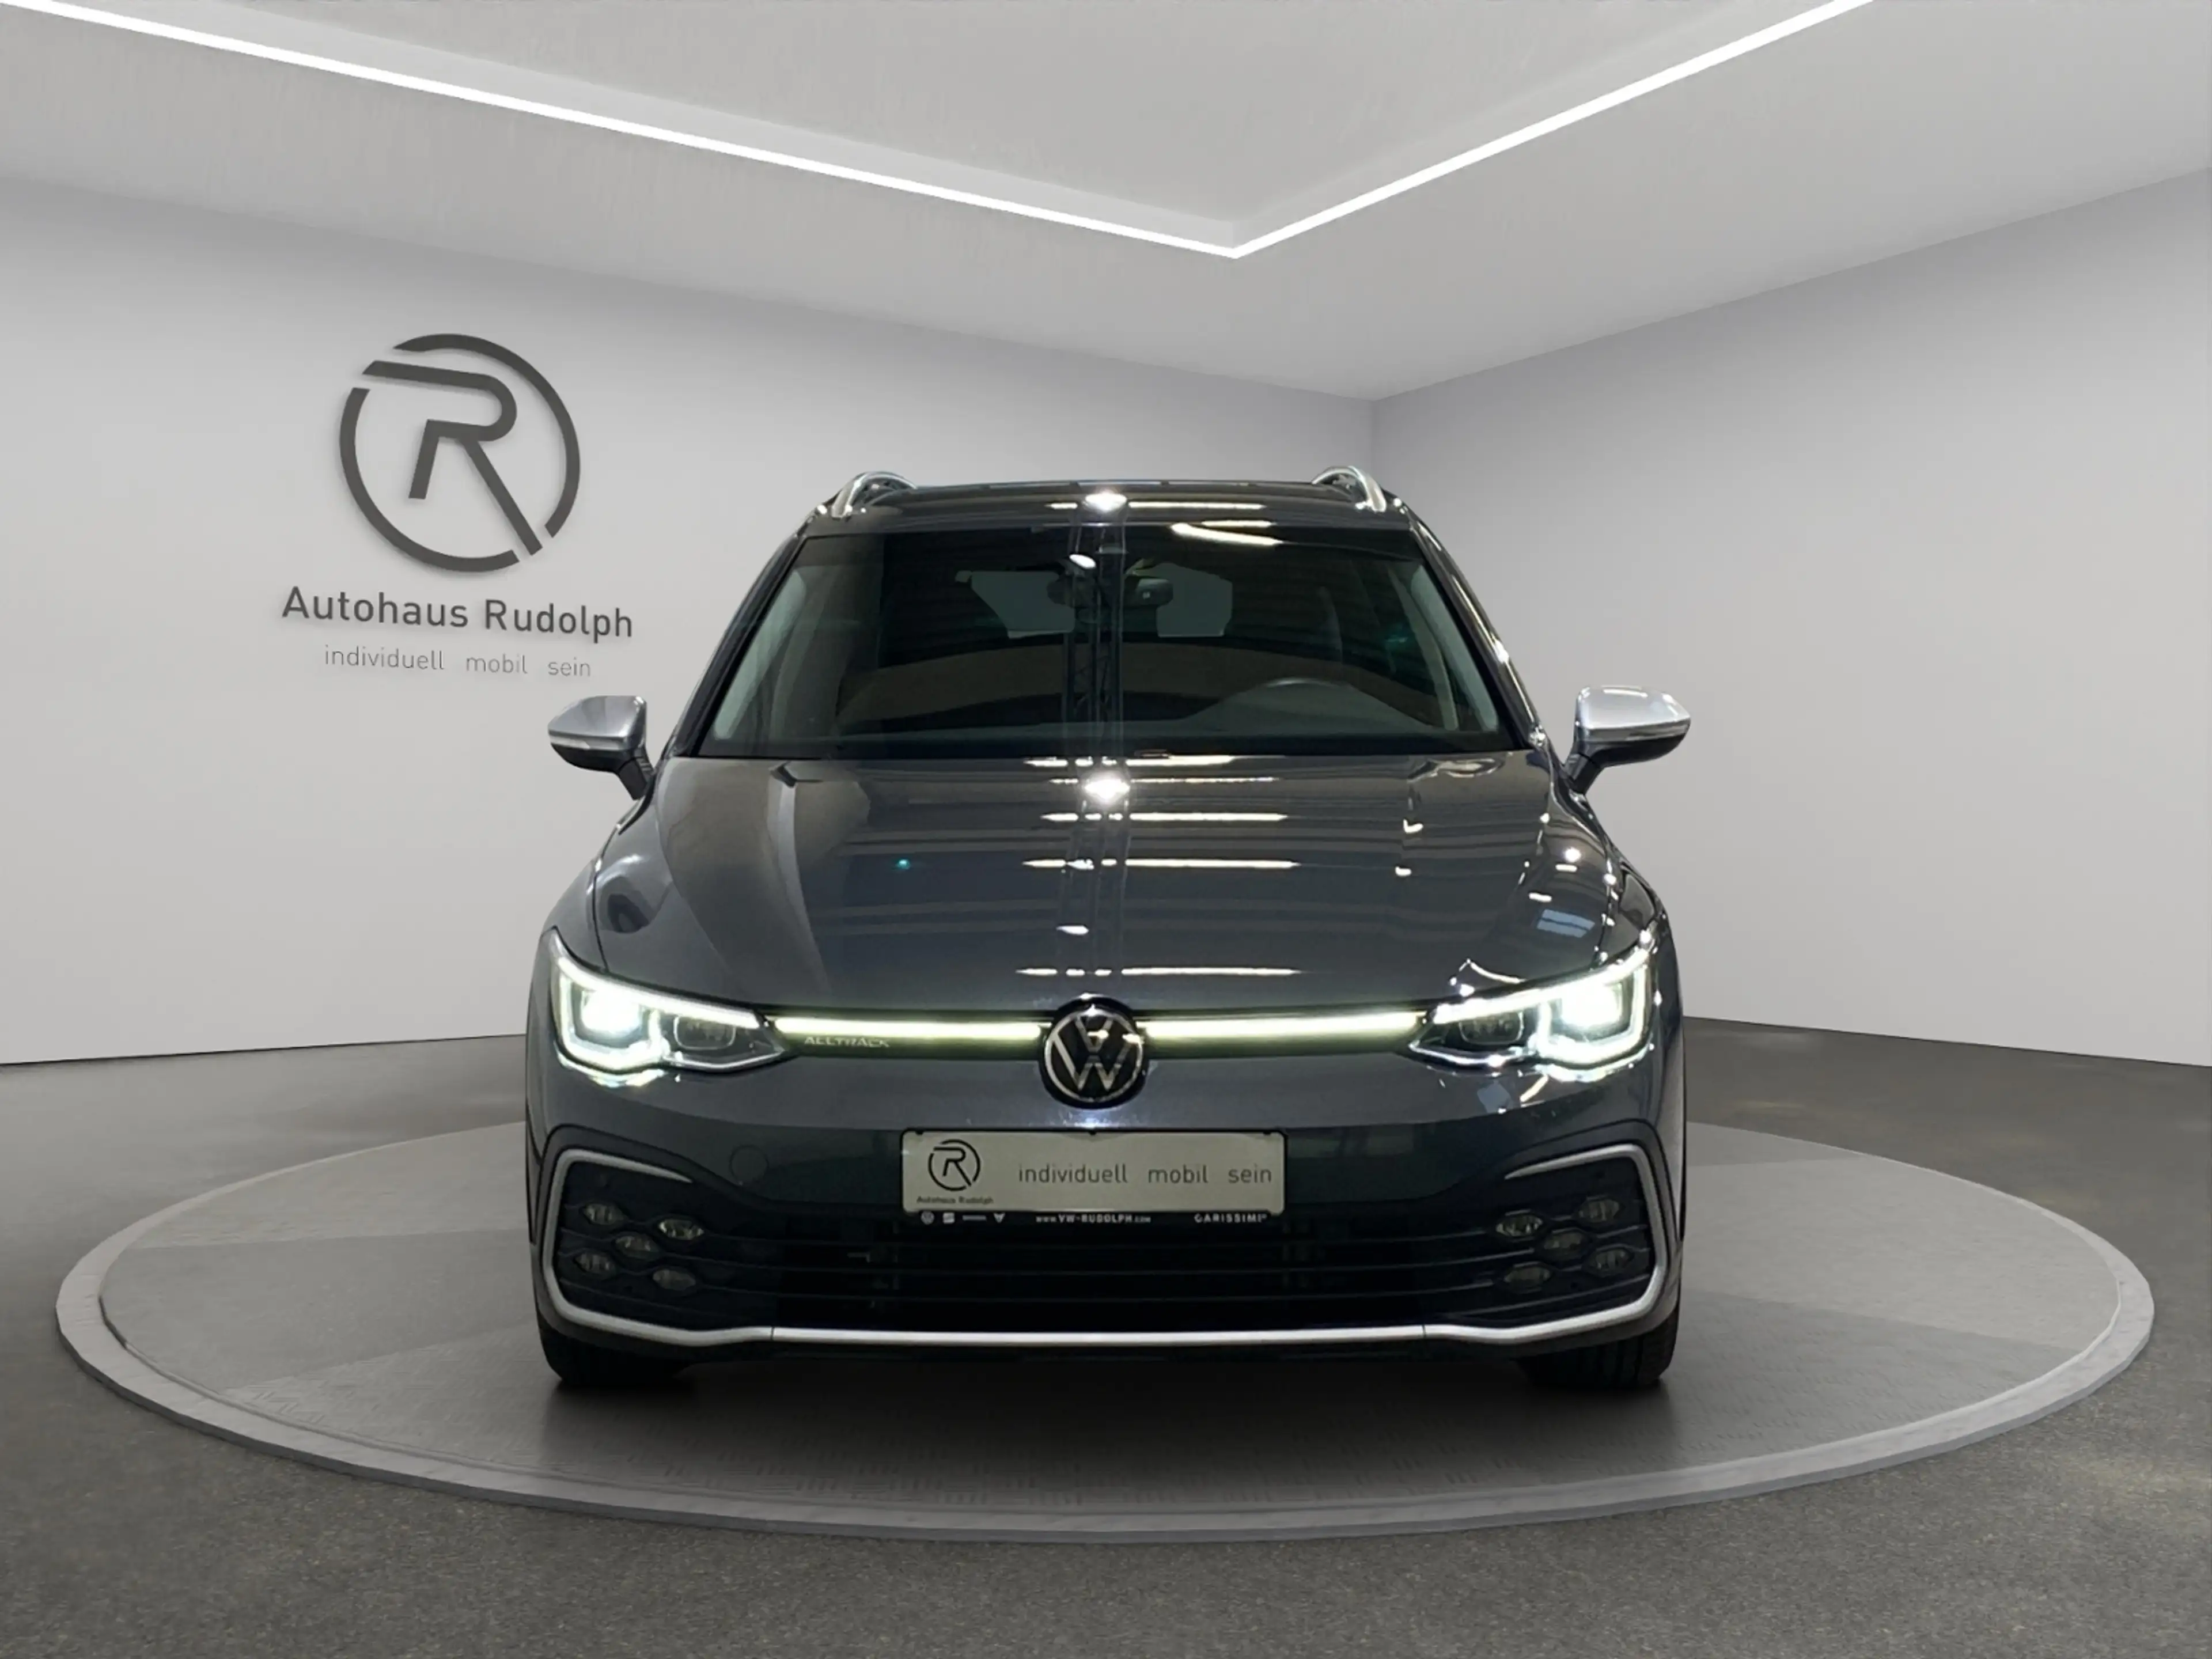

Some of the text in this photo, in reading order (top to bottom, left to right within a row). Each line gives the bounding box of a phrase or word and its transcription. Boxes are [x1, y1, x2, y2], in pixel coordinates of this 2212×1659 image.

[362, 359, 543, 556] R
[282, 586, 632, 644] Autohaus Rudolph
[324, 645, 591, 677] individuell mobil sein
[804, 1036, 891, 1048] ALLTRACK
[1018, 1164, 1272, 1184] individuell mobil sein
